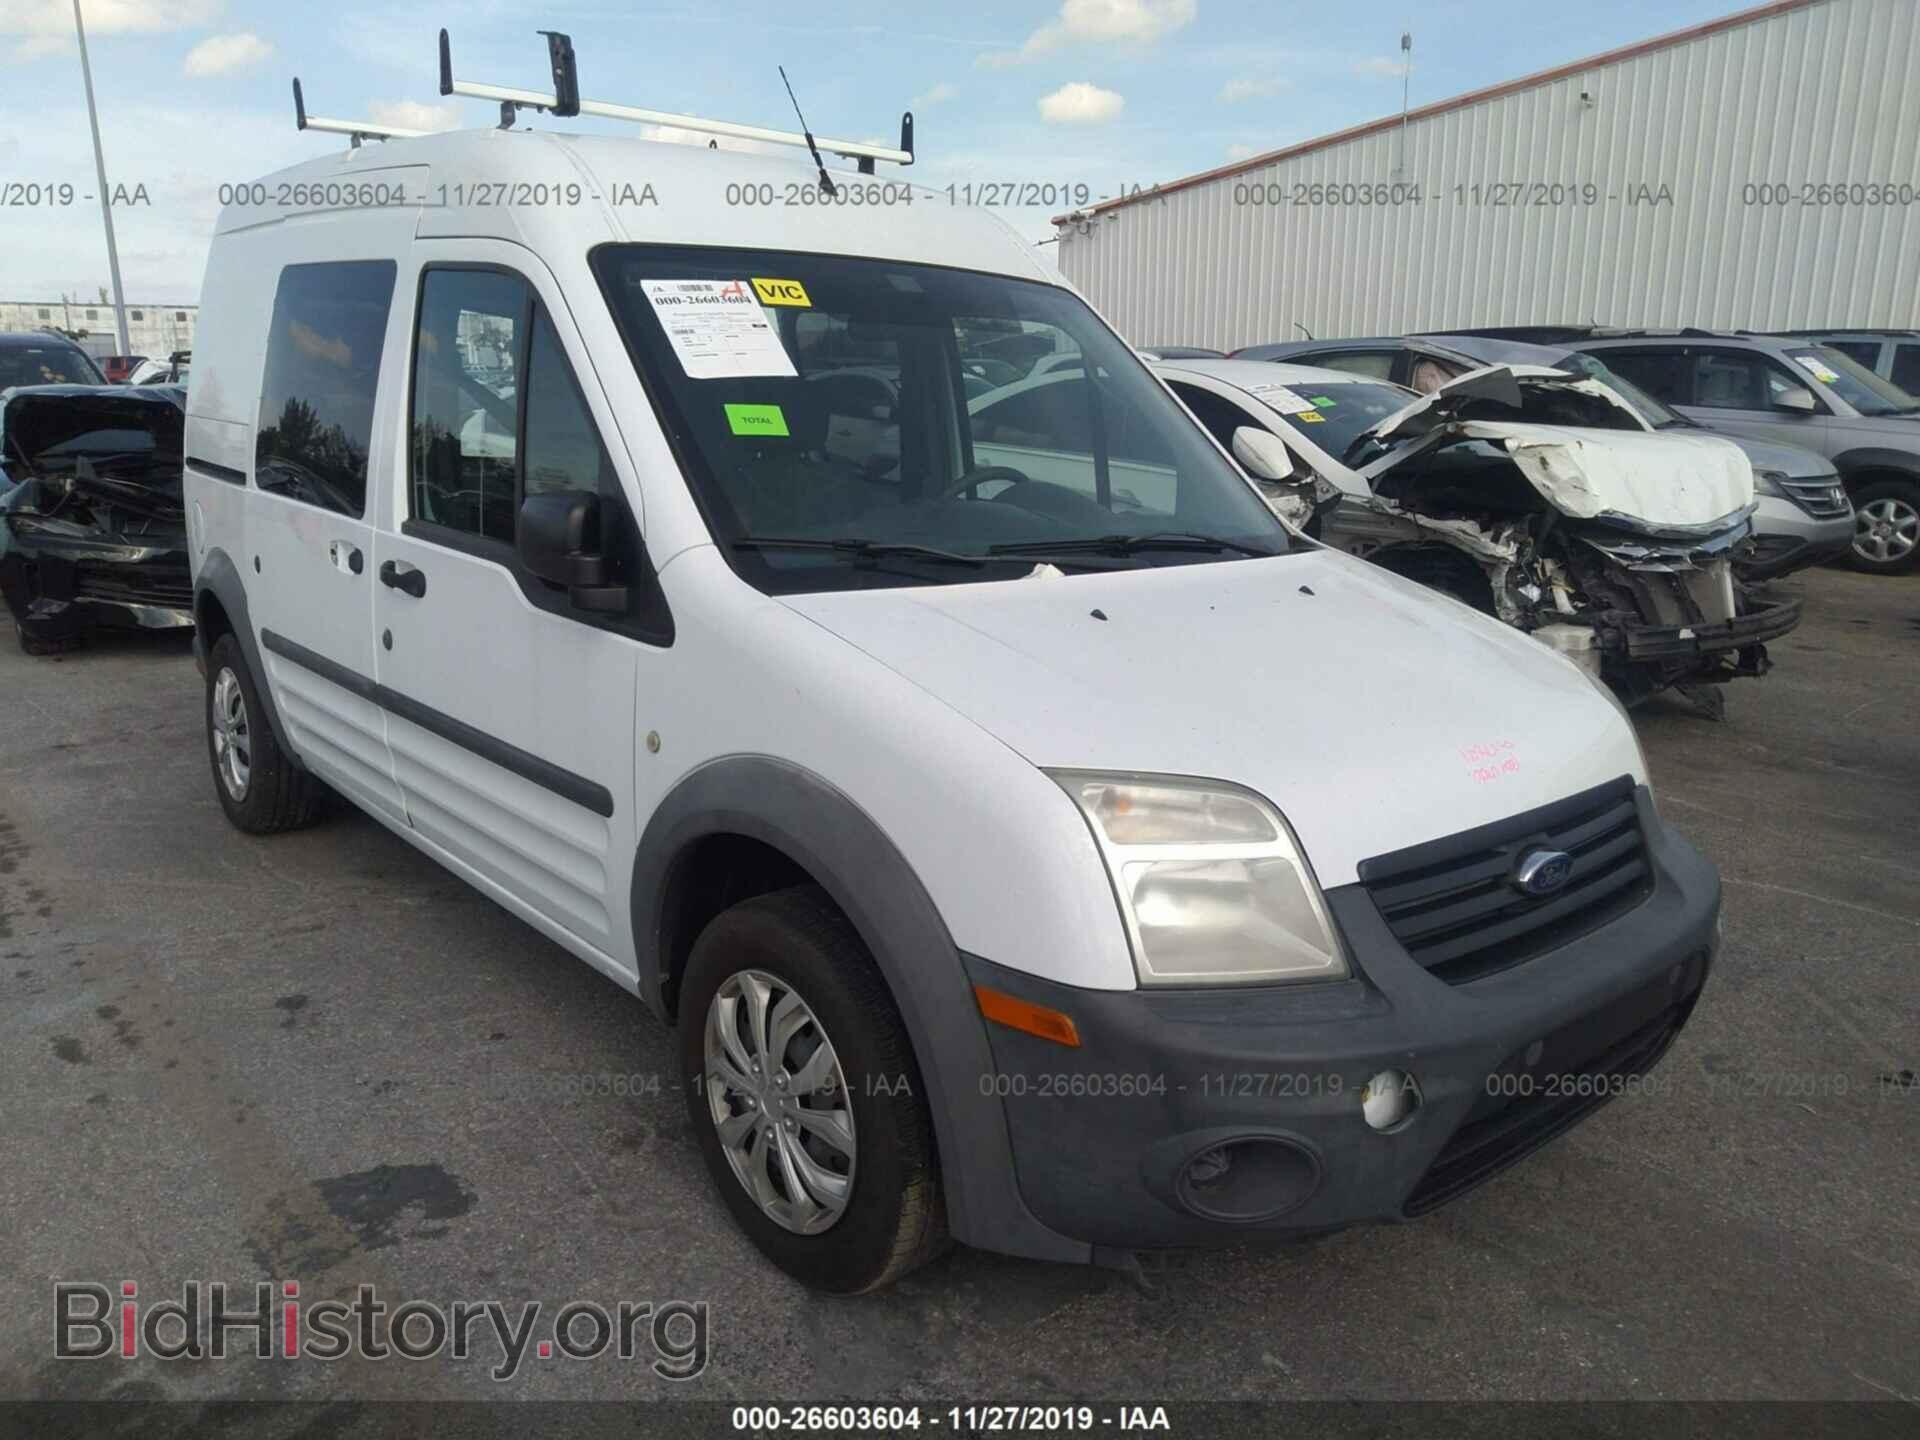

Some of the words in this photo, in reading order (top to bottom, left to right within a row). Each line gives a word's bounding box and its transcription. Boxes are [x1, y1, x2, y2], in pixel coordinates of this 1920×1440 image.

[759, 283, 803, 300] VIC
[655, 295, 751, 306] 000-26603604
[741, 416, 774, 425] TOTAL
